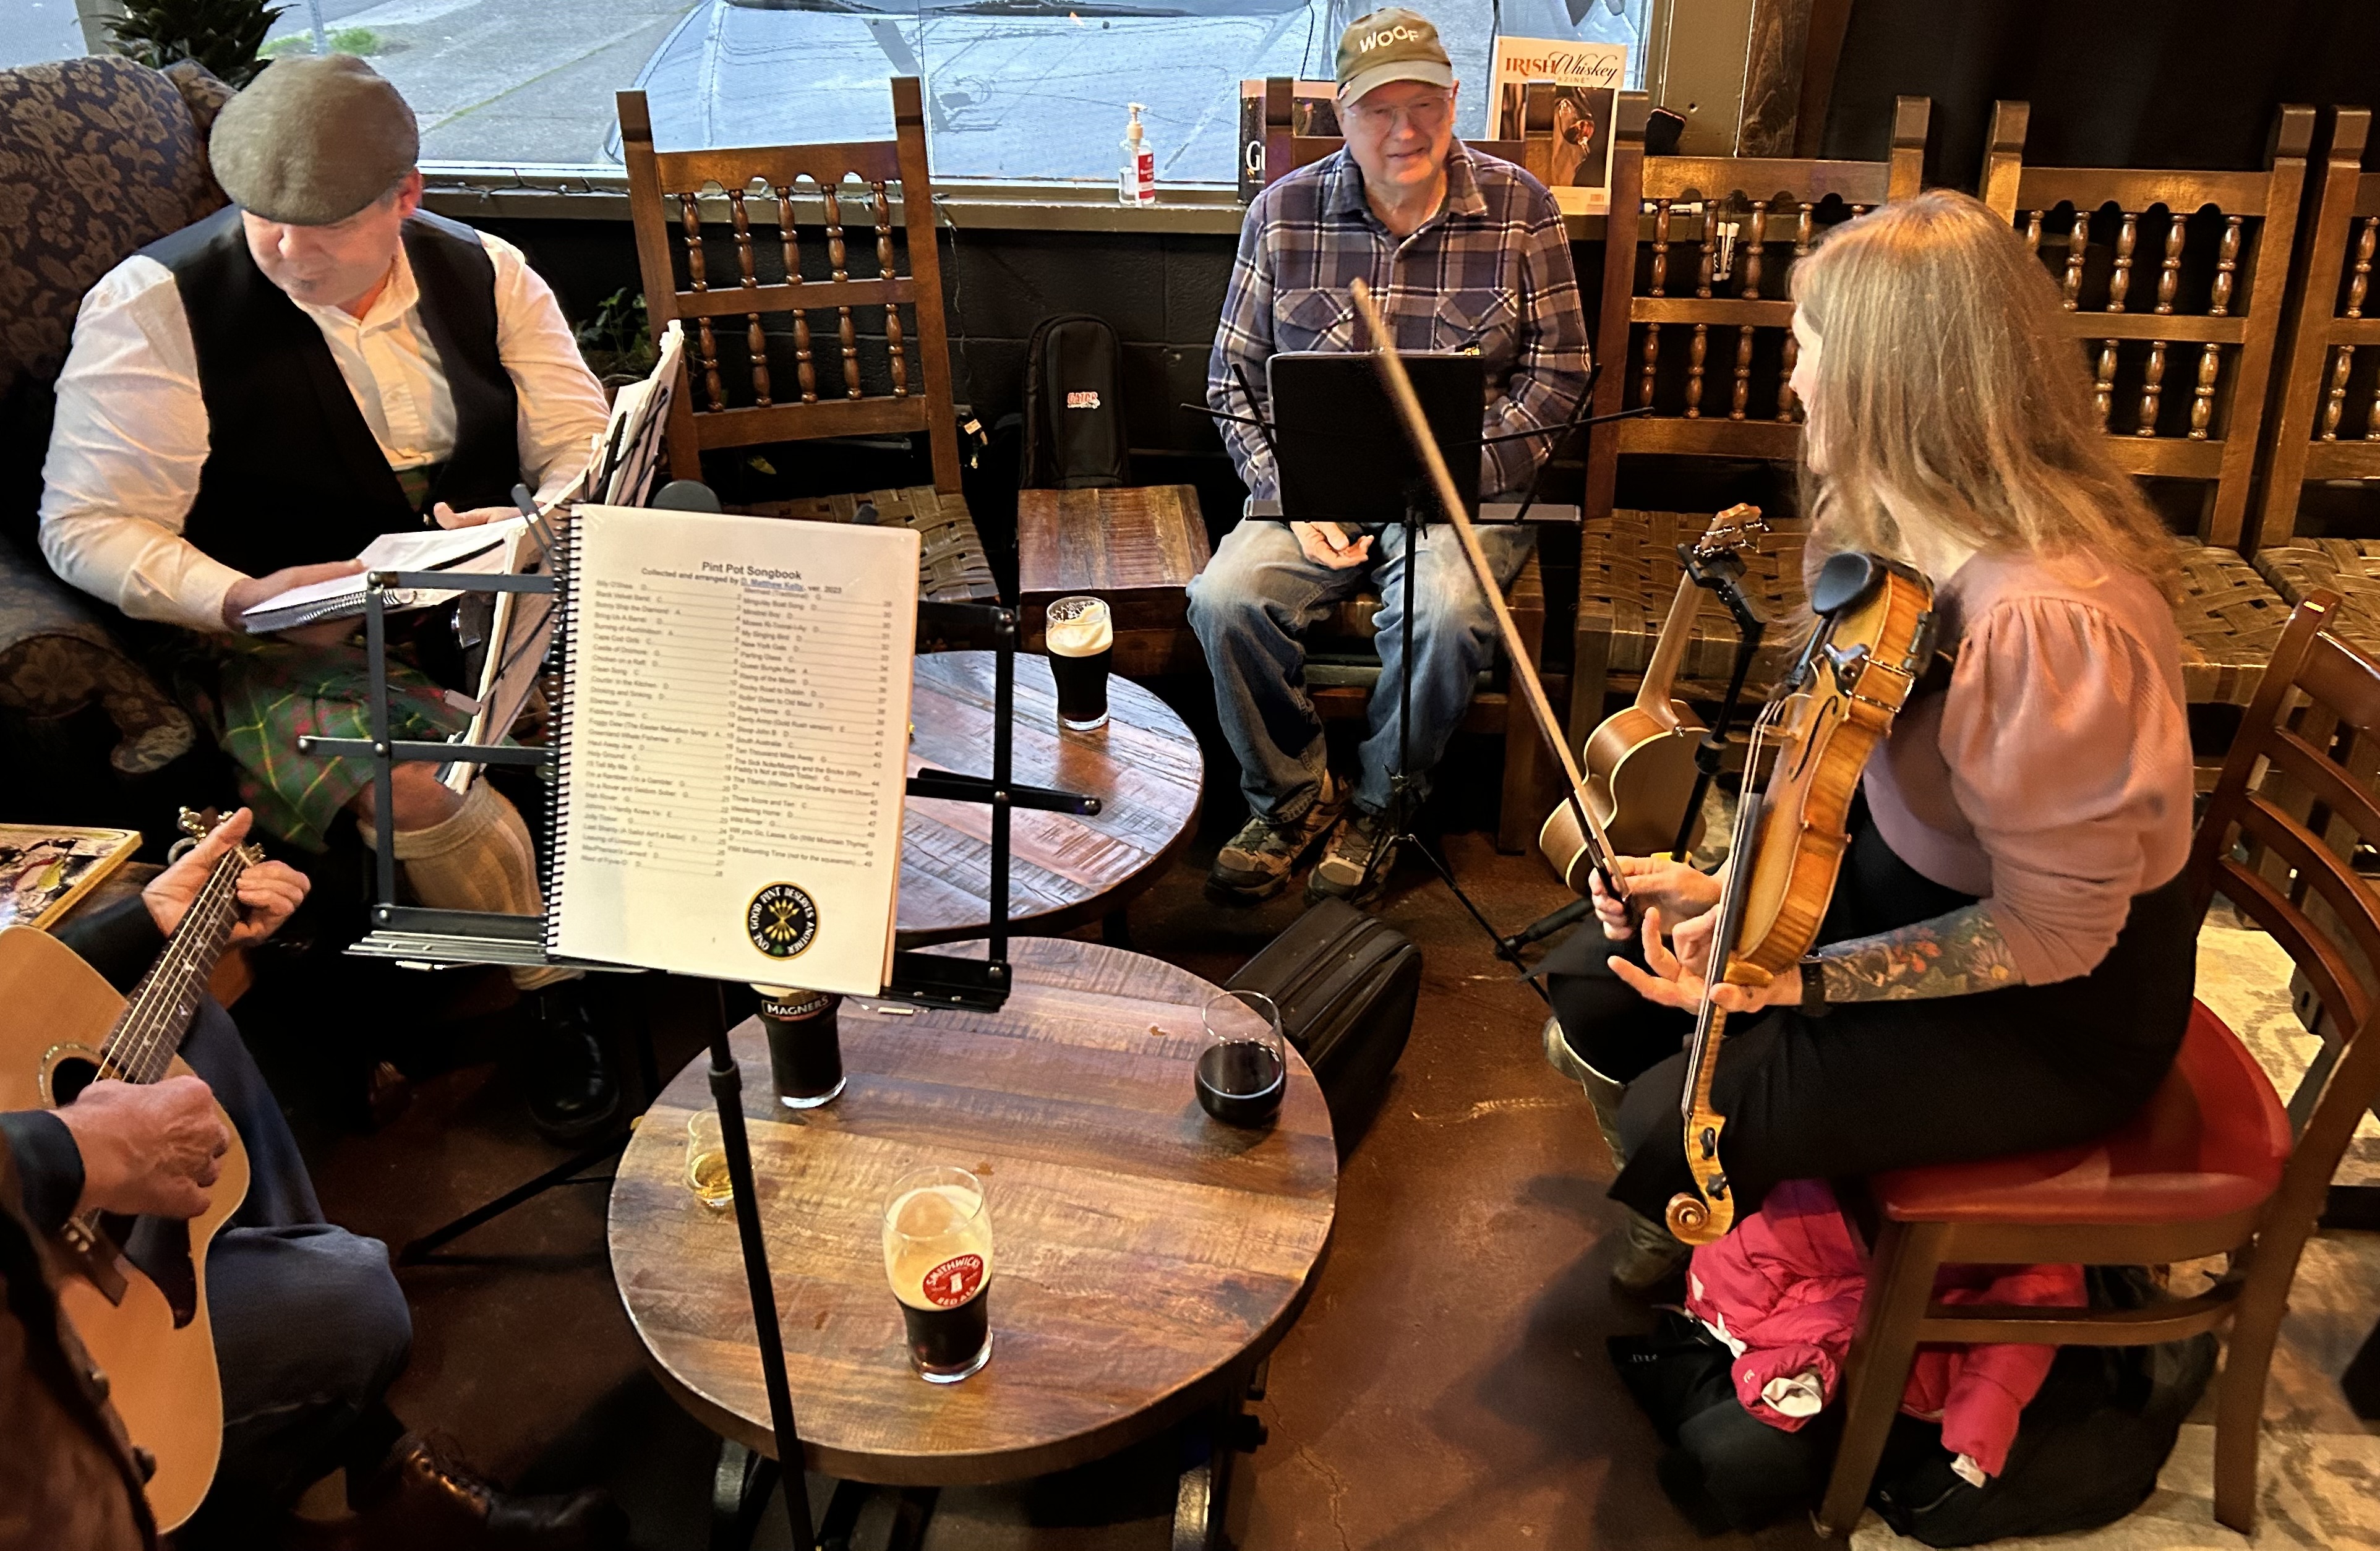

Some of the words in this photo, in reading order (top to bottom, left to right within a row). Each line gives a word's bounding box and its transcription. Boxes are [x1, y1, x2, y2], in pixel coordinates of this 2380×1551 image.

[1359, 25, 1419, 53] WOOF
[1505, 58, 1556, 76] IRISH
[1548, 51, 1618, 86] Whiskey
[641, 568, 677, 578] Collected
[695, 574, 728, 584] arranged
[730, 576, 739, 585] by
[702, 562, 723, 573] Pint
[726, 564, 744, 575] Pot
[747, 566, 802, 580] Songbook
[784, 887, 815, 918] DESERVES
[750, 903, 763, 930] GOOD
[753, 931, 771, 951] ONE
[787, 921, 815, 955] ANOTHER
[767, 995, 829, 1015] MAGNERS
[936, 1297, 957, 1305] RED
